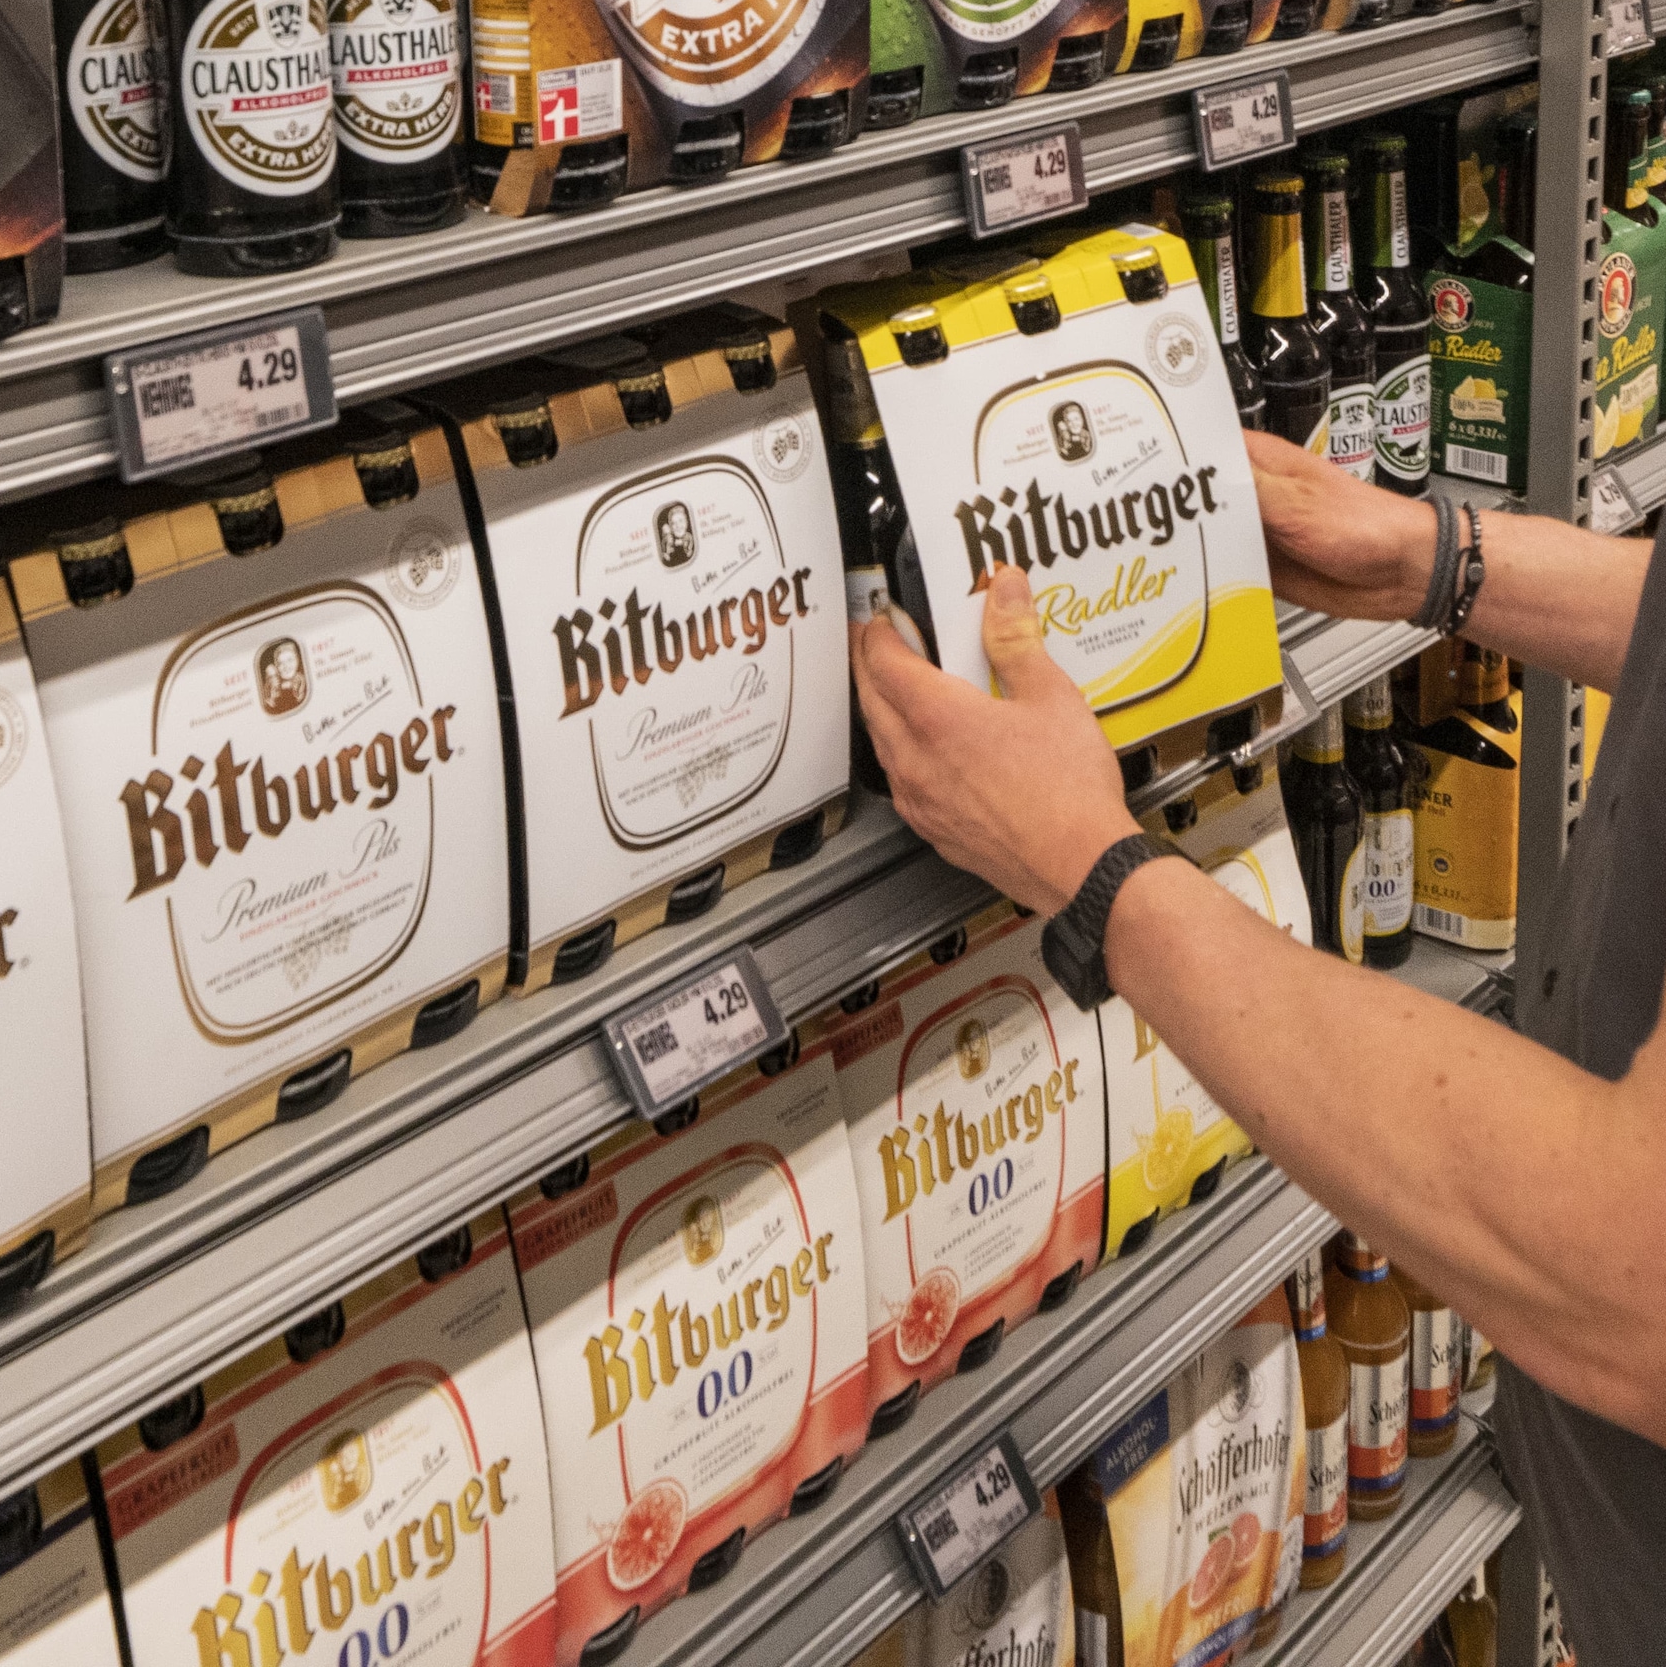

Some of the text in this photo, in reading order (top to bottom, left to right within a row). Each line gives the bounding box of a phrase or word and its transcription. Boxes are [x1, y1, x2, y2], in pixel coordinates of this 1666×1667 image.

[329, 29, 455, 68] LAUSTHALE
[661, 6, 764, 57] EXTRA
[345, 87, 455, 137] EXTRA HERB
[1251, 92, 1278, 121] 4.29
[230, 130, 299, 169] EXTRA
[1034, 147, 1067, 180] 4.29
[1327, 199, 1346, 285] CLAUSTHALER
[1394, 178, 1408, 260] CLAUSTHALER
[1223, 245, 1237, 335] CLAUSTHALER
[237, 347, 298, 393] 4.29
[1445, 334, 1504, 363] Radler
[953, 462, 1218, 598] Bitburger
[1036, 555, 1177, 638] Radler
[549, 566, 813, 721] Bitburger
[615, 705, 714, 763] Premium
[722, 661, 769, 711] Pils
[118, 703, 458, 903] Bitburger
[200, 816, 402, 944] Premium Pils
[701, 980, 750, 1028] 4.29
[876, 1056, 1081, 1225] Bitburger
[967, 1156, 1015, 1218] 0.0
[581, 1230, 835, 1438] Bitburger
[696, 1348, 754, 1421] 0.0
[972, 1460, 1013, 1511] 4.29
[1176, 1418, 1292, 1536] Schöfferhofer
[1194, 1479, 1273, 1534] WEIZEN-MIX
[190, 1456, 512, 1667] Bitburger
